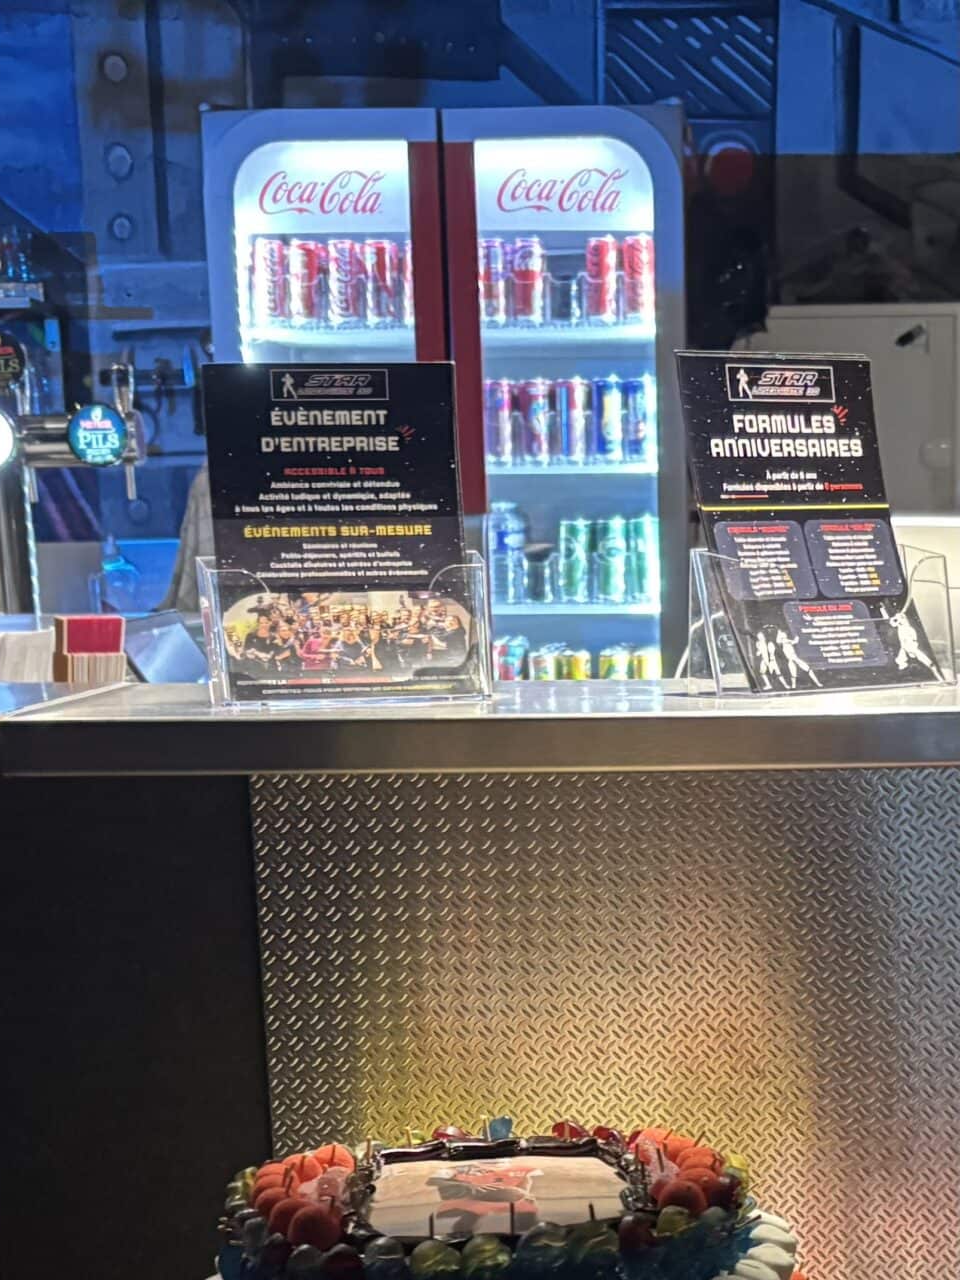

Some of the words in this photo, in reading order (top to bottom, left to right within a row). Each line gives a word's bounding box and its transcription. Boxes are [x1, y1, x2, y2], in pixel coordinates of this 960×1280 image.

[259, 170, 387, 215] Coca-Cola
[497, 168, 629, 213] Coca-Cola
[758, 371, 818, 386] STAR
[733, 414, 836, 434] FORMULES
[79, 434, 120, 450] PILS
[261, 436, 400, 452] D'ENTREPRISE
[710, 438, 863, 457] ANNIVERSAIRES
[340, 524, 432, 537] SUR-MESURE
